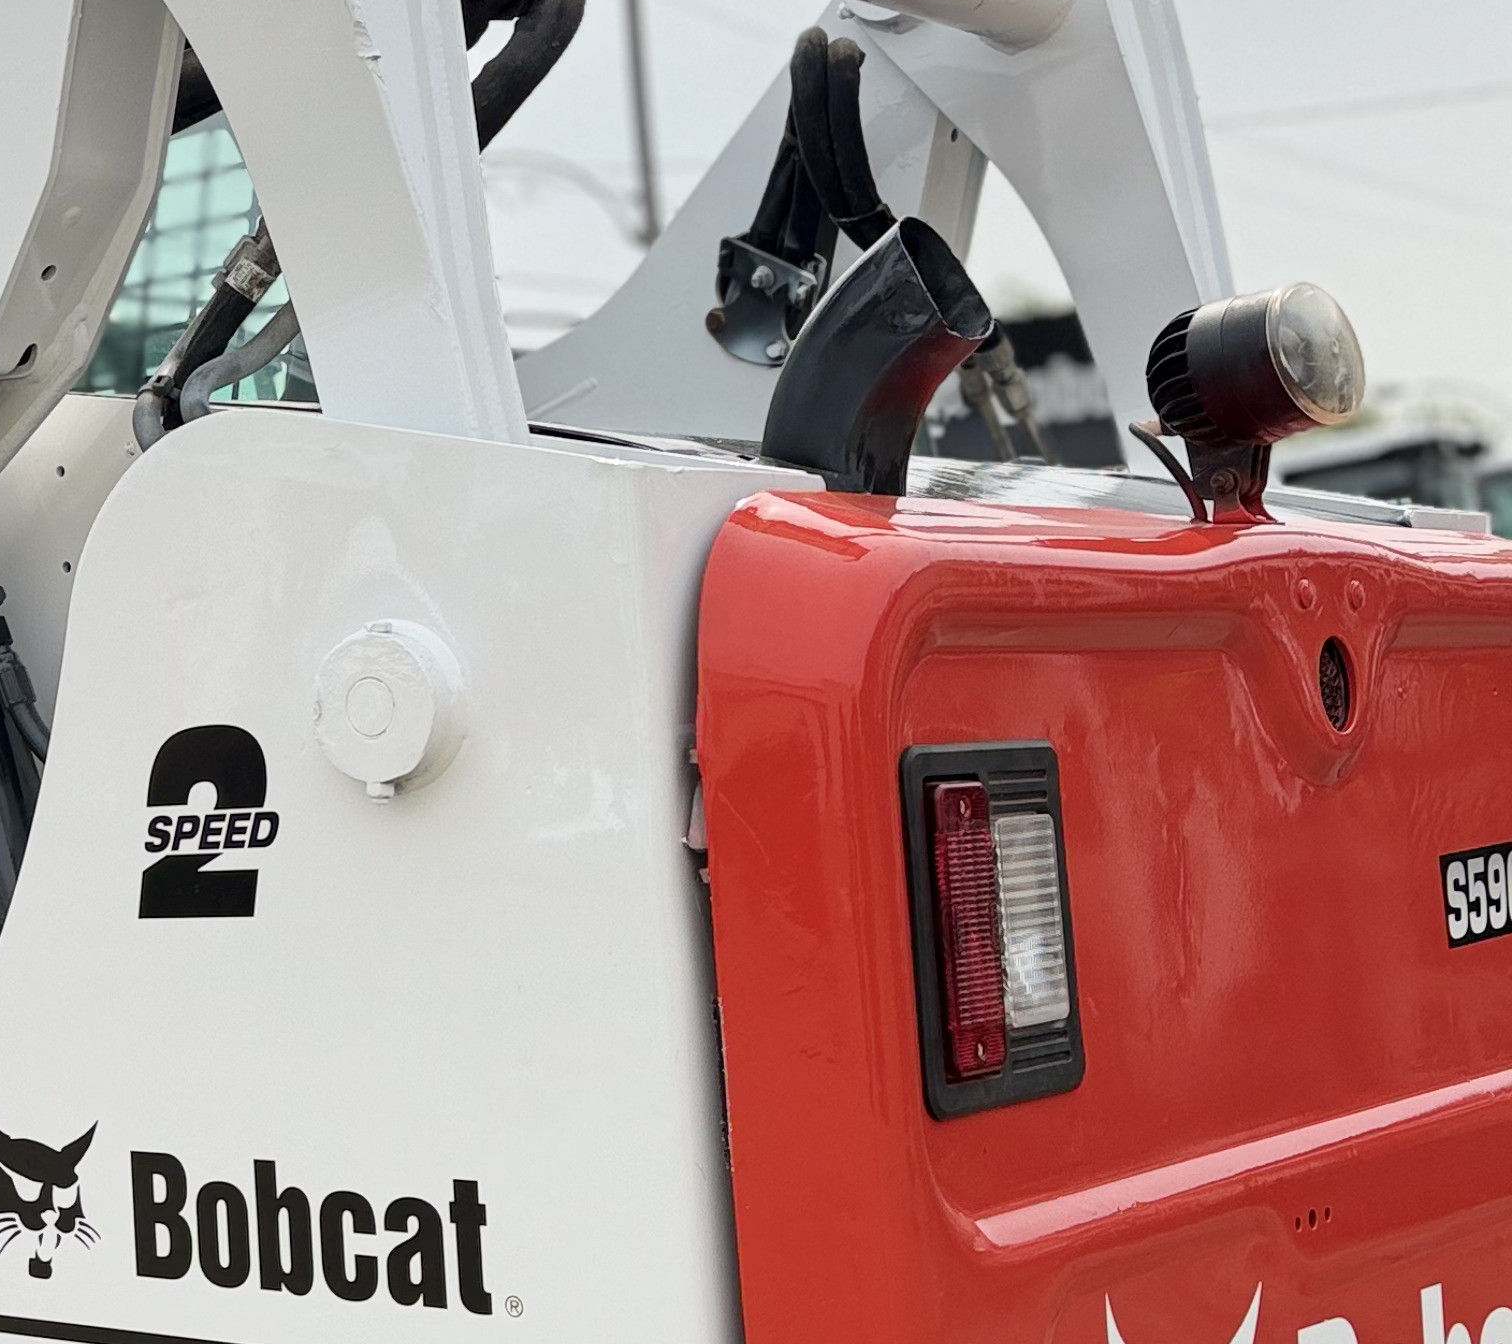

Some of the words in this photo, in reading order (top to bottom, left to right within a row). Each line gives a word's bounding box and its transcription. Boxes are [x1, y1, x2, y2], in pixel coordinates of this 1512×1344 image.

[138, 724, 267, 919] 2
[144, 811, 280, 853] SPEED
[1446, 850, 1512, 940] S59
[130, 1151, 493, 1315] Bobcat
